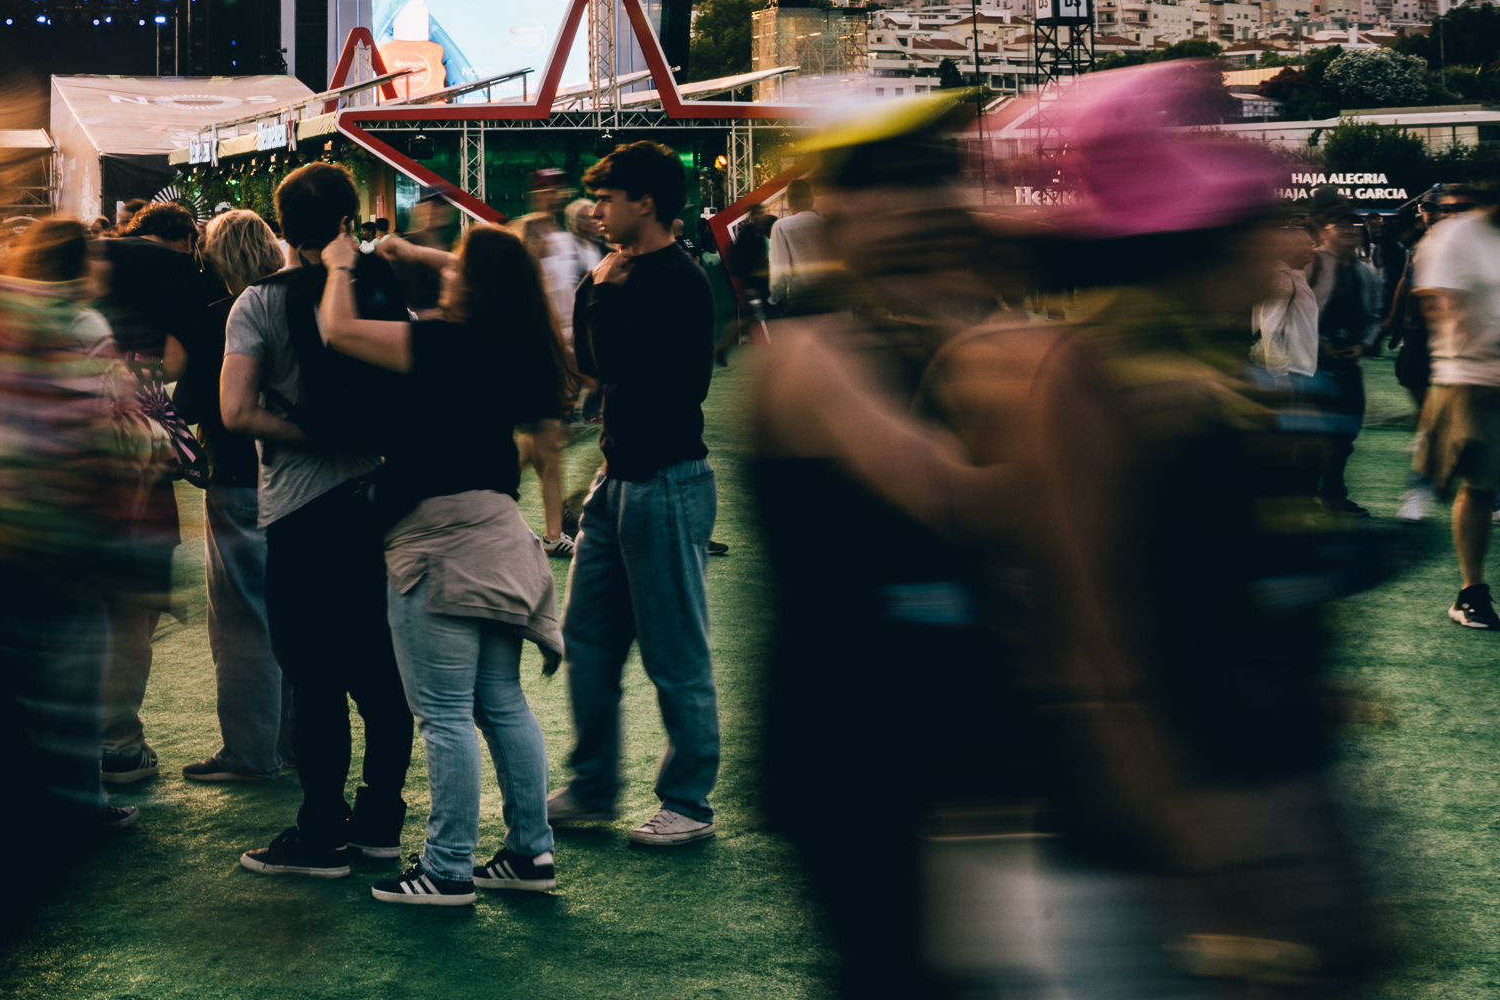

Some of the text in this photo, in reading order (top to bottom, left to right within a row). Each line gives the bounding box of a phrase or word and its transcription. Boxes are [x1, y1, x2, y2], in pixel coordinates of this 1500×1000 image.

[462, 67, 493, 76] NOVO
[109, 94, 277, 110] NOS
[1291, 173, 1388, 187] HAJA ALEGRIA
[1274, 188, 1308, 201] HAJA
[1355, 188, 1408, 199] GARCIA
